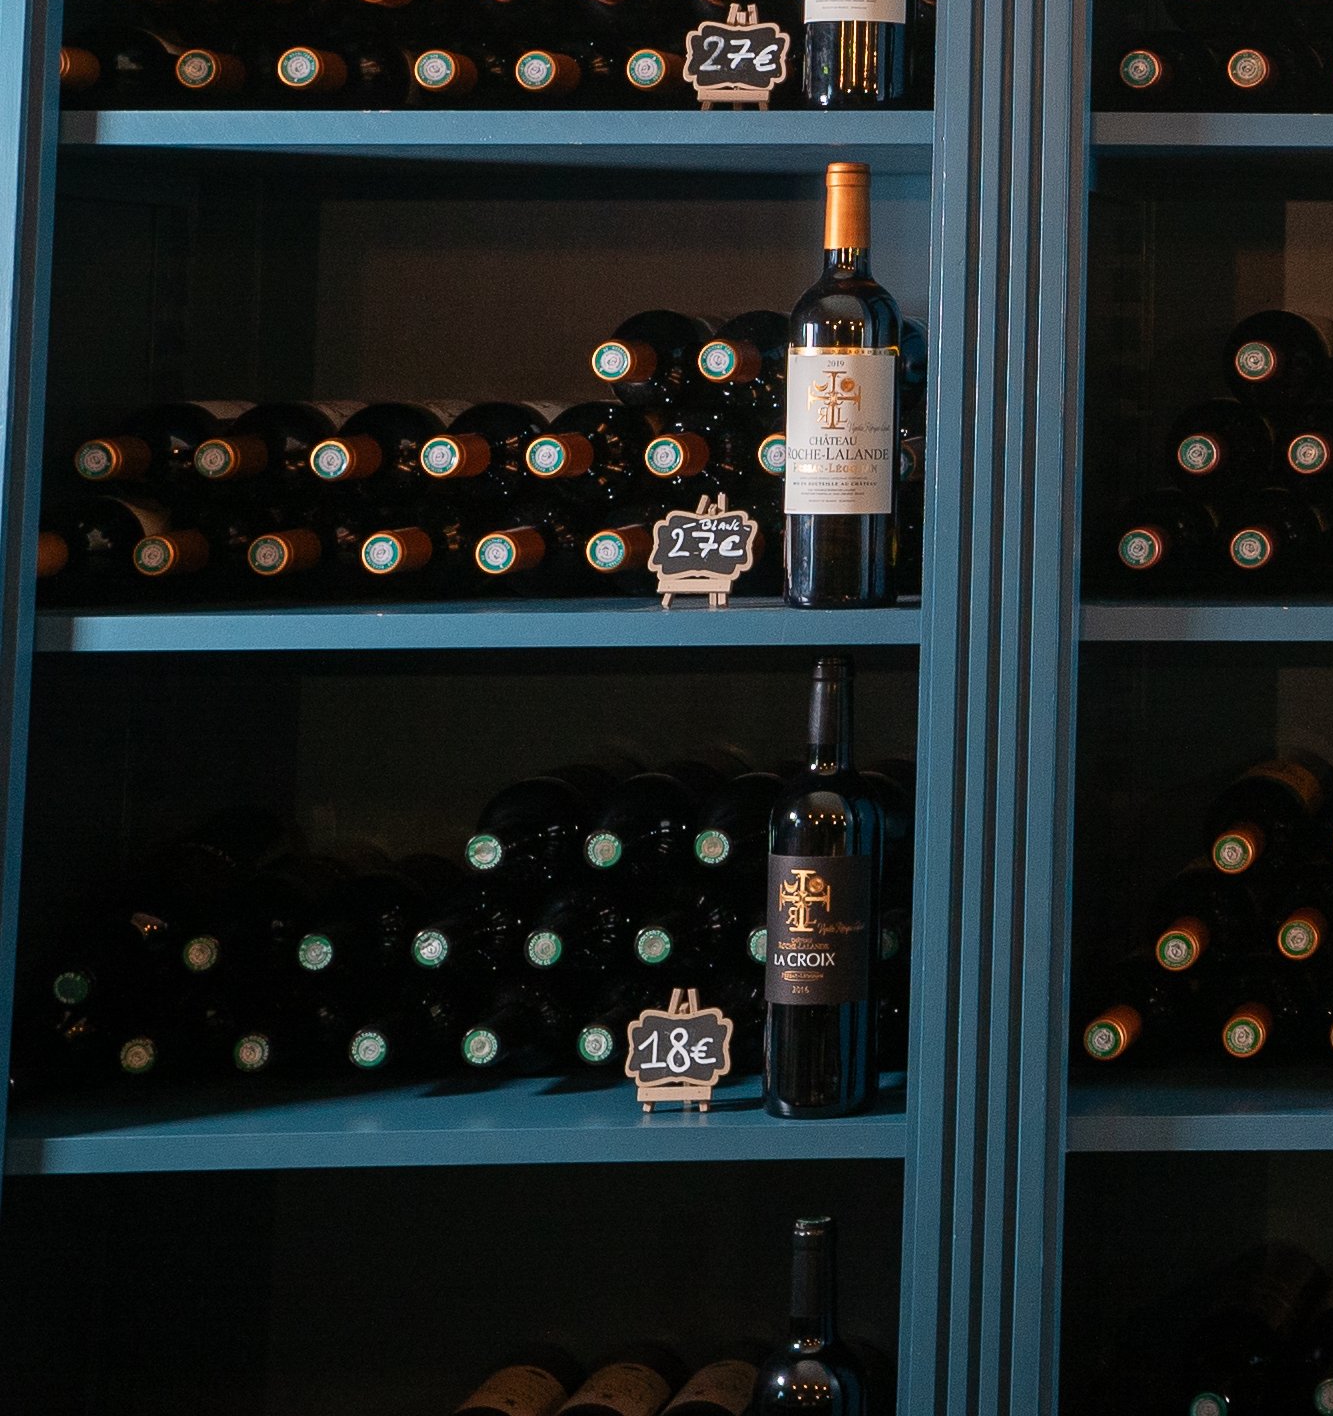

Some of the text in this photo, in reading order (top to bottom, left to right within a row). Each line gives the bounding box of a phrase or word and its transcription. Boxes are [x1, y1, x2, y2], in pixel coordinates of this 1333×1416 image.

[699, 35, 779, 73] 27€
[809, 434, 858, 446] CHÂTEAU
[787, 446, 889, 461] ROCHE-LALANDE
[697, 518, 742, 533] BLANC
[670, 532, 744, 561] 27€
[637, 1027, 718, 1076] 18€
